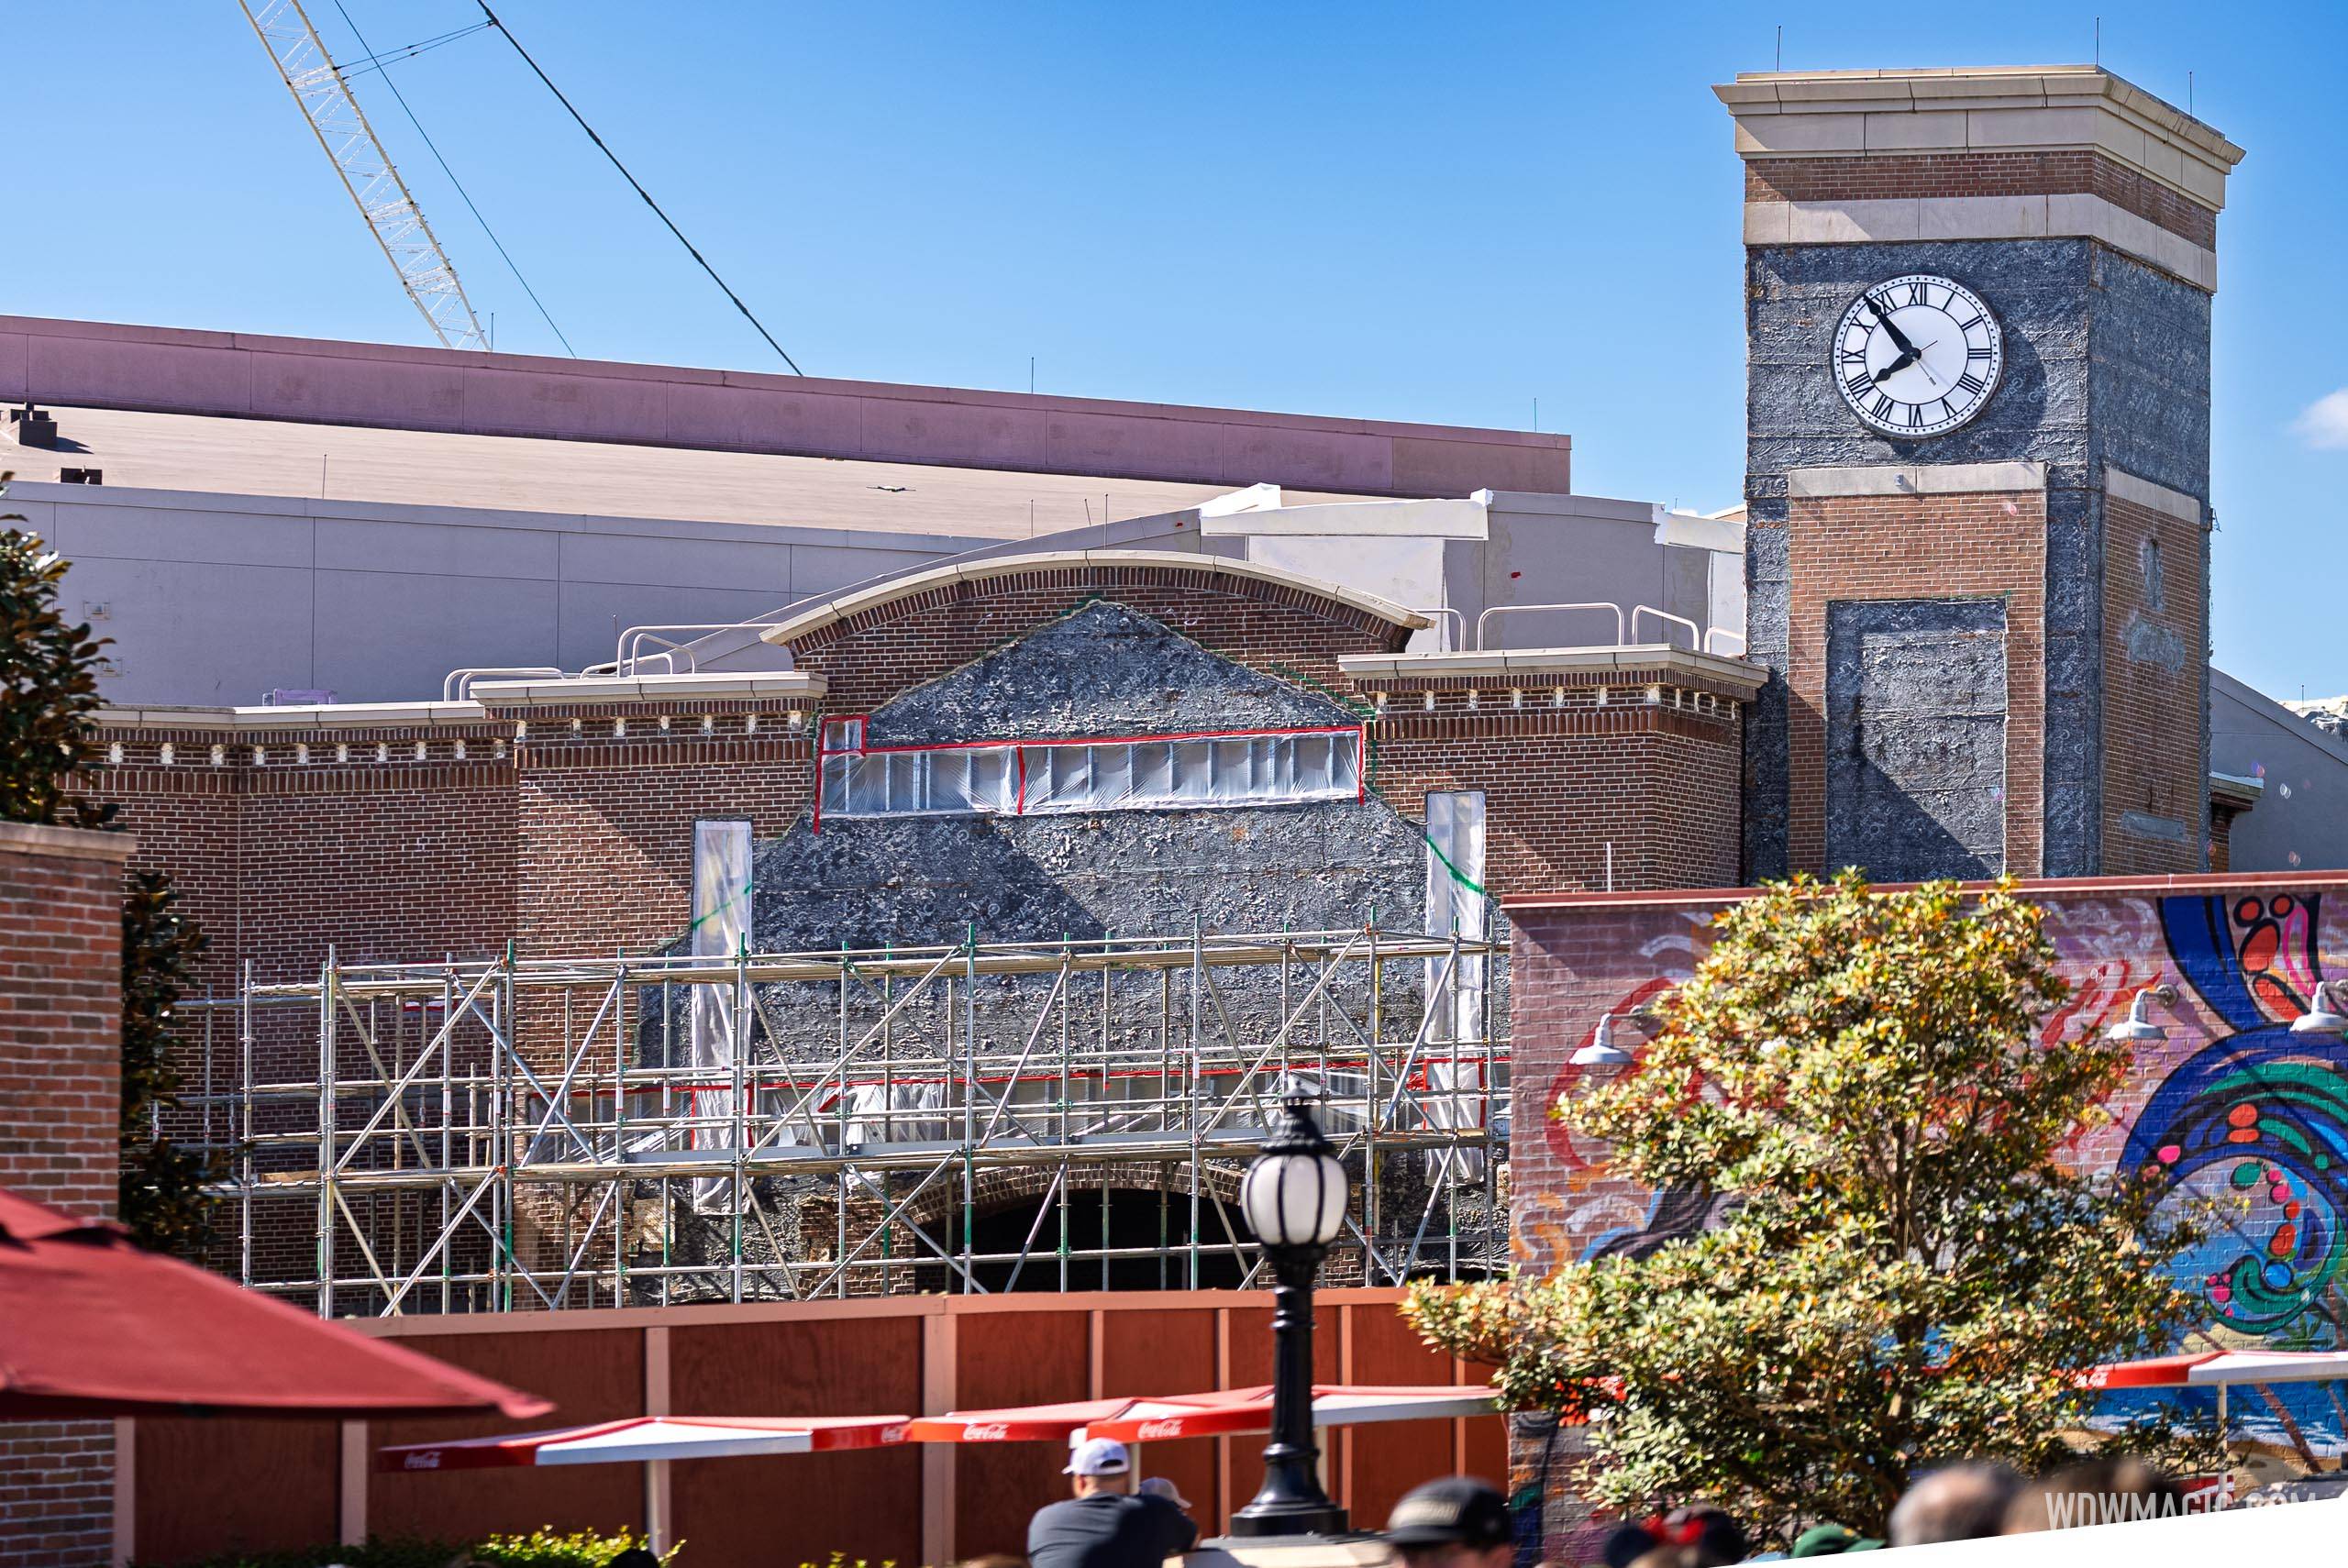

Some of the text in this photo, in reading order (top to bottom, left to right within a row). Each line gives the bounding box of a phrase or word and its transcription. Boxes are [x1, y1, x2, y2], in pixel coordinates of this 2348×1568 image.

[1874, 291, 1897, 315] XI
[1908, 283, 1927, 305] XII
[1943, 292, 1955, 311] I
[1850, 316, 1875, 336] X
[1960, 315, 1983, 331] II
[1842, 349, 1866, 363] IX
[1967, 348, 1991, 359] III
[1847, 373, 1876, 401] VIII
[1957, 373, 1984, 395] IIII
[1873, 395, 1895, 421] VII
[1909, 404, 1923, 427] VI
[1942, 398, 1957, 418] V
[962, 1423, 1010, 1441] Coca-Cola
[1136, 1419, 1183, 1439] Coca-Cola
